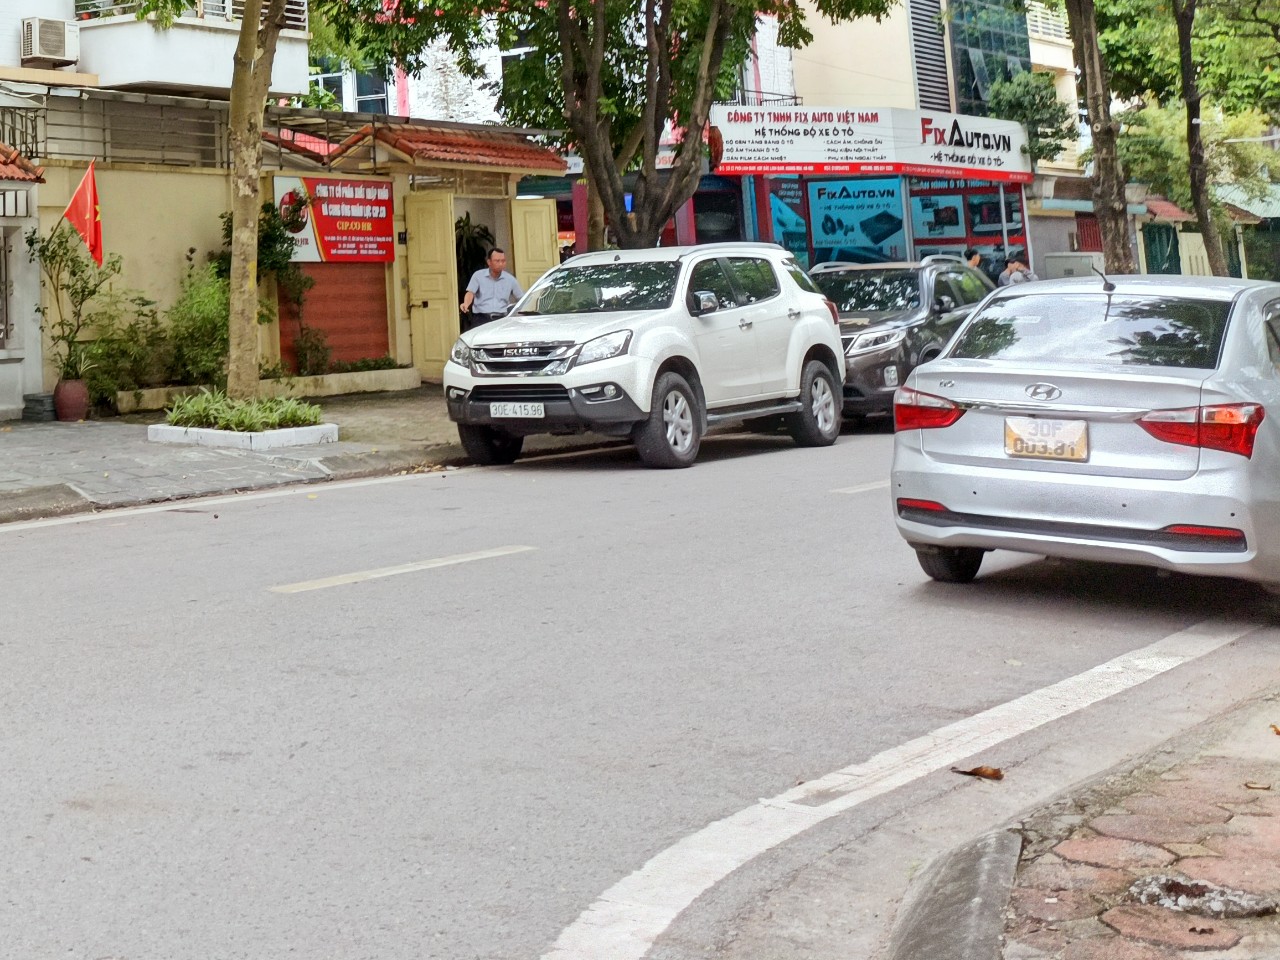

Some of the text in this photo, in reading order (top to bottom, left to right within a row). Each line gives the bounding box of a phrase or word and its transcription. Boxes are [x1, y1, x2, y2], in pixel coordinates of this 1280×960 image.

[727, 110, 879, 124] CÔNG TY TNHH FIX AUTO VIỆT NAM
[754, 125, 854, 138] HỆ THỐNG ĐỘ XE Ô TÔ
[503, 347, 539, 356] ISUZU
[1028, 420, 1063, 437] 30F
